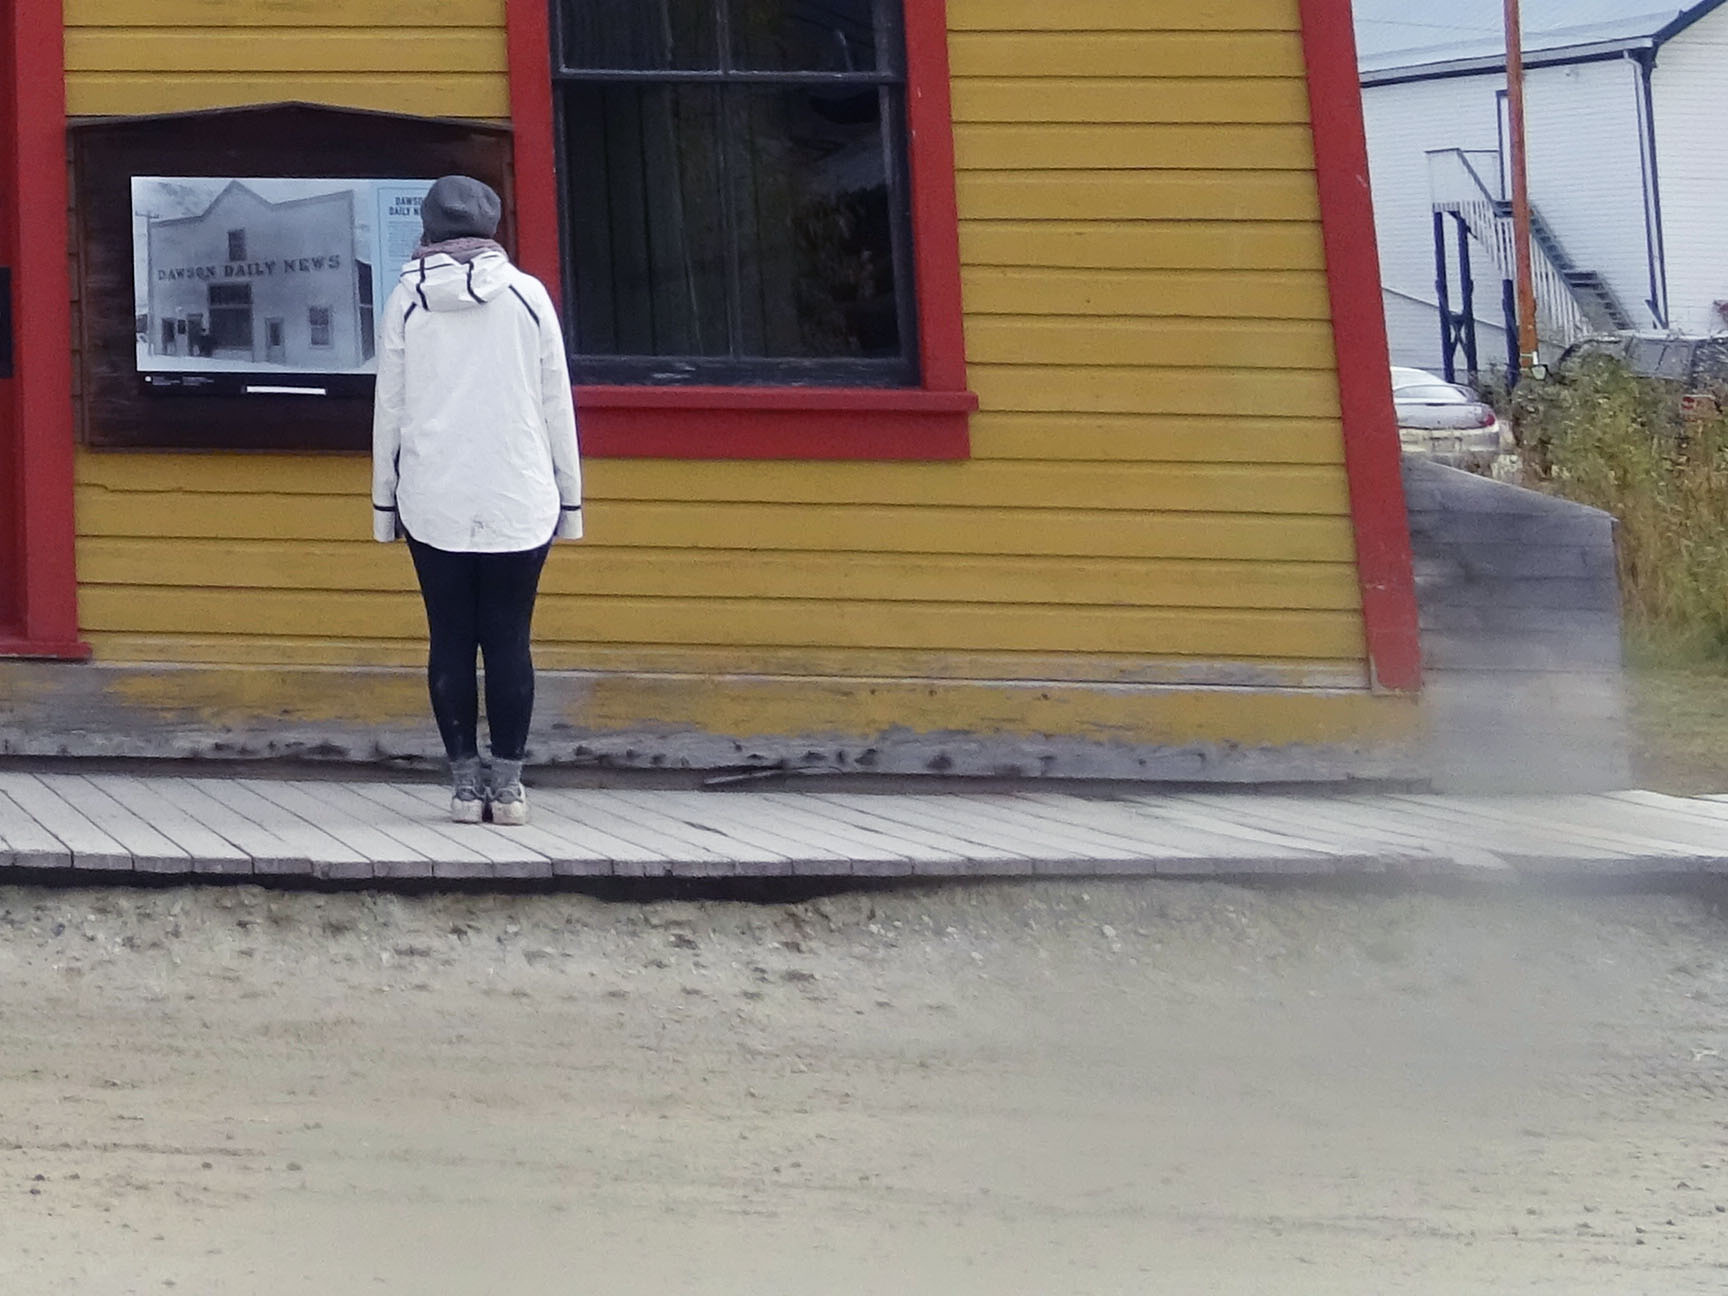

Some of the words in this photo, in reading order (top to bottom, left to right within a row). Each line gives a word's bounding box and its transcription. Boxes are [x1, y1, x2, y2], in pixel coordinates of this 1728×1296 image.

[394, 196, 425, 207] DAWSO
[157, 265, 217, 281] DAWSON
[223, 260, 277, 277] DAILY
[283, 254, 342, 273] NEWS
